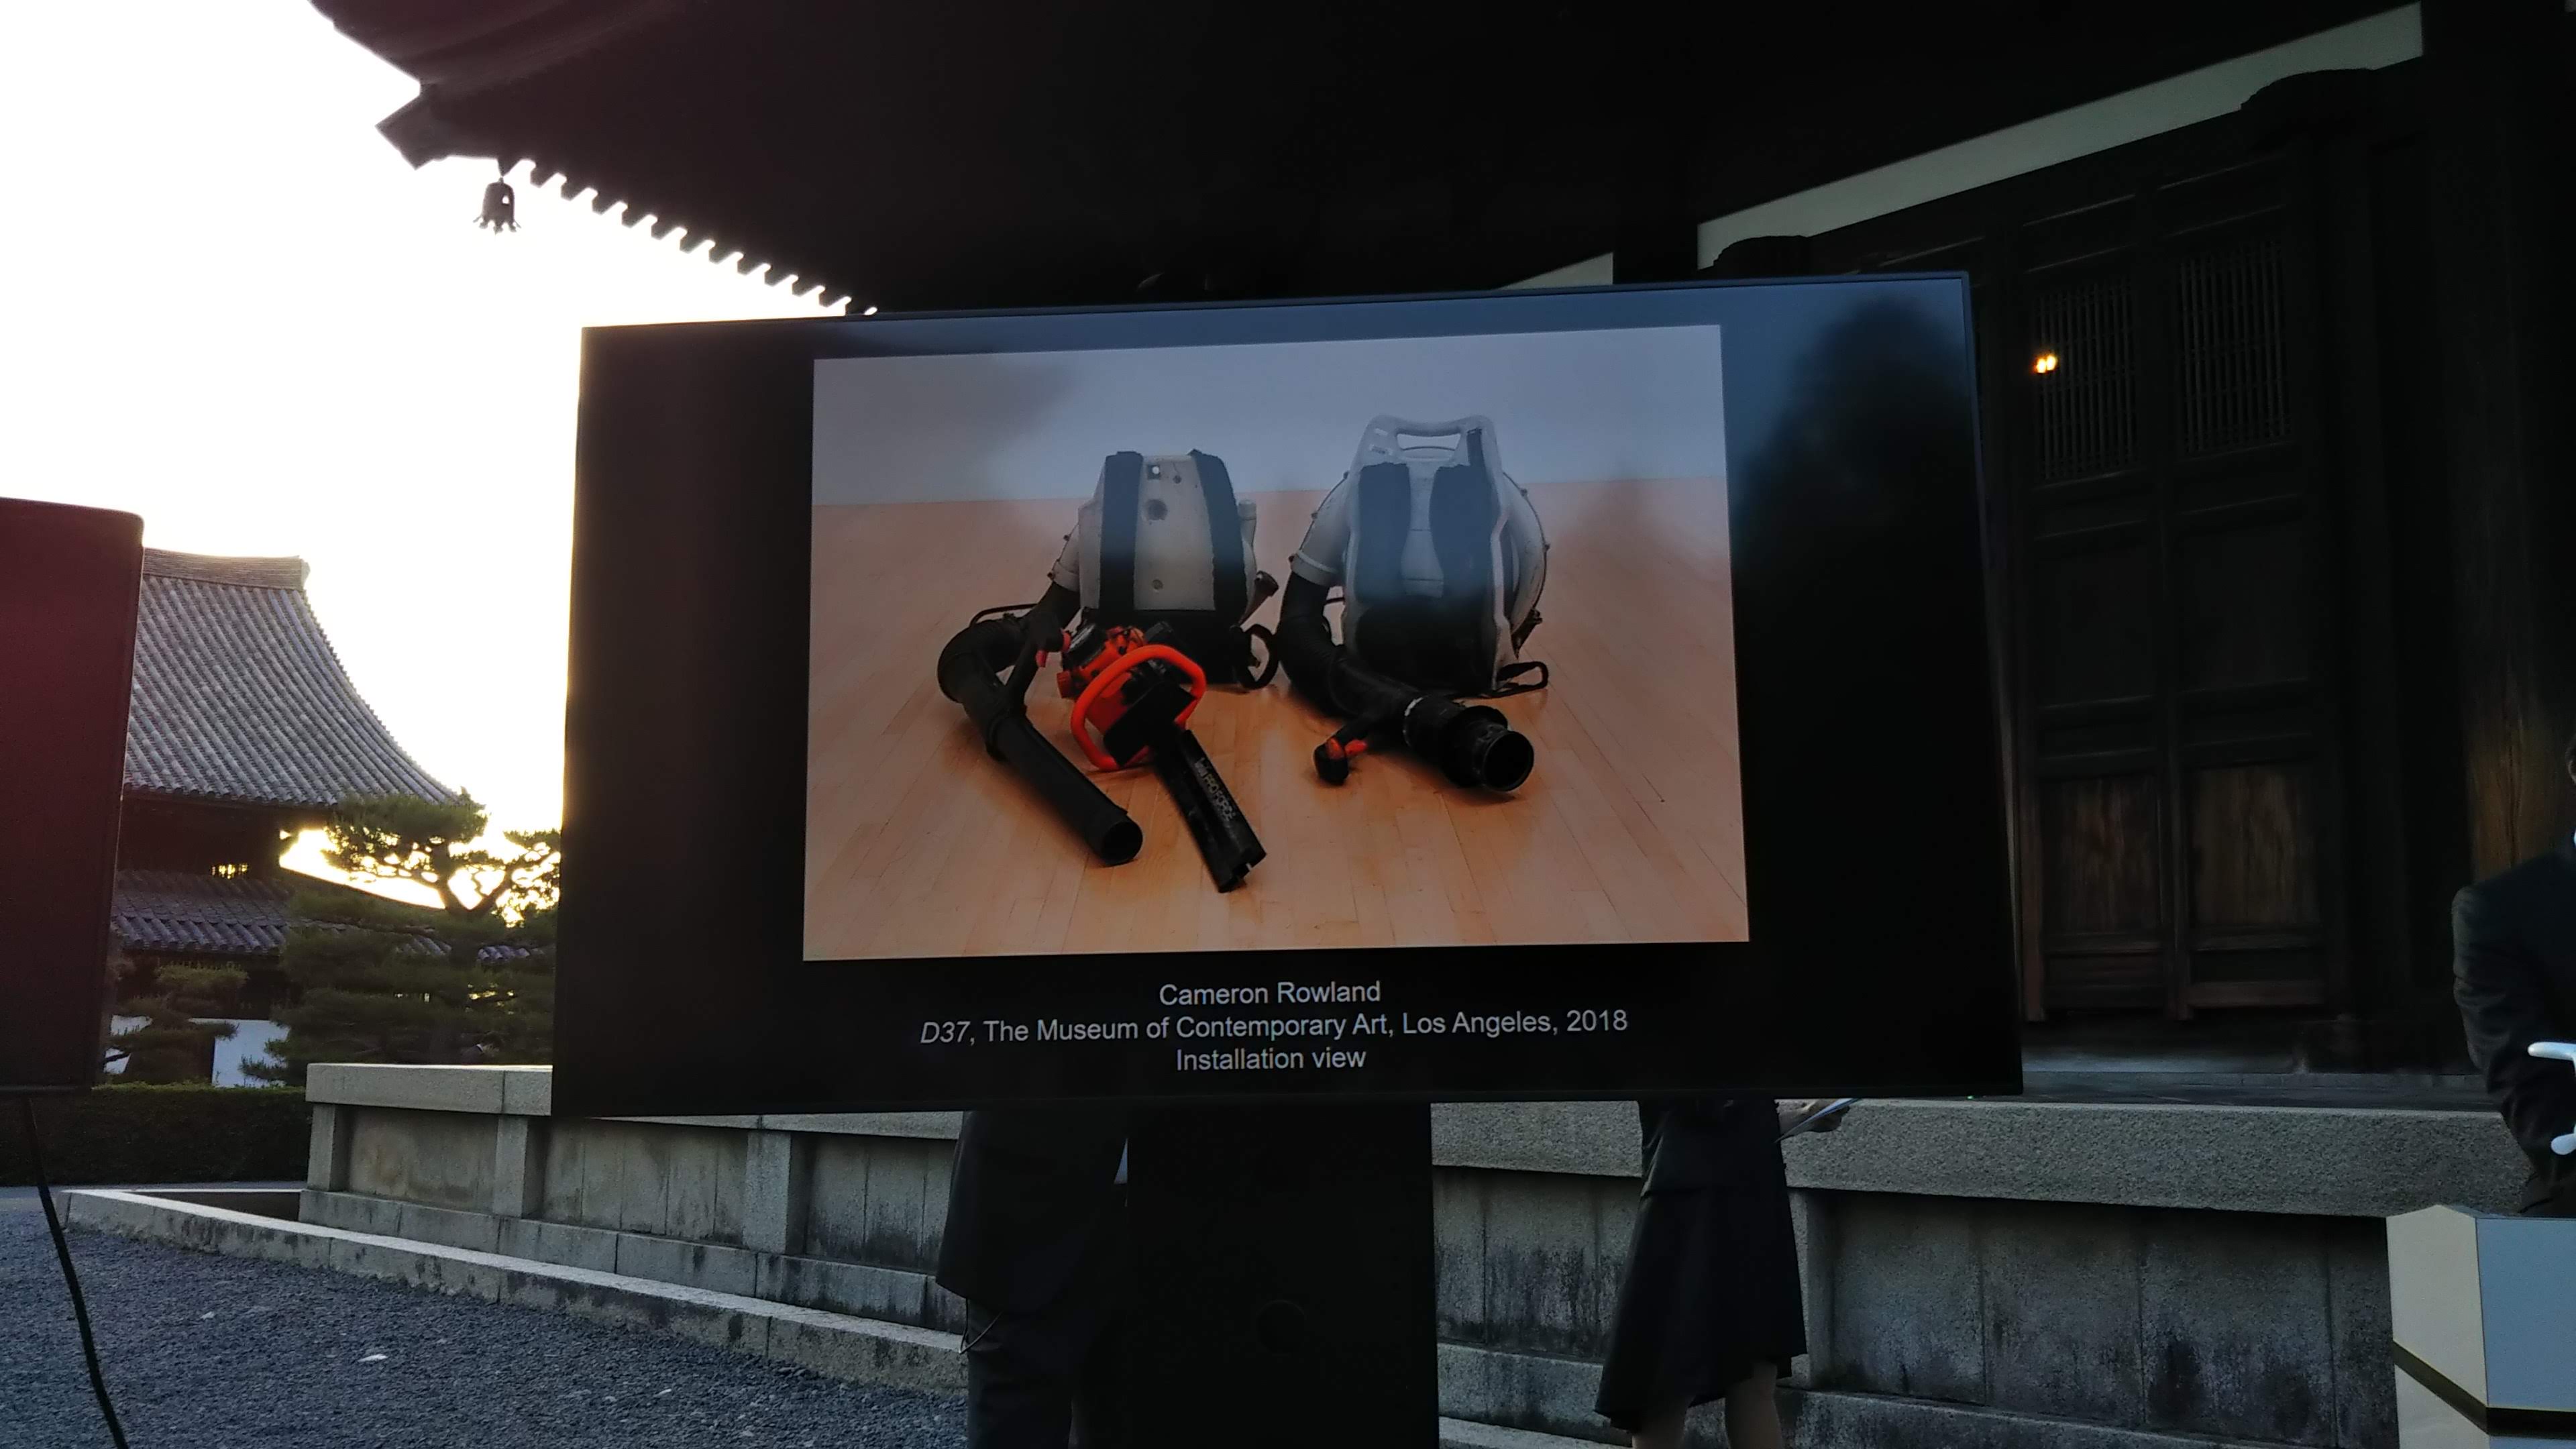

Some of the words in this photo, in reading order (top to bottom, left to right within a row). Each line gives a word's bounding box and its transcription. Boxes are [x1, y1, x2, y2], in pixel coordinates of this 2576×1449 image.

[1159, 984, 1268, 1006] Cameron
[1277, 981, 1380, 1003] Rowland
[920, 1020, 975, 1045] D37,
[983, 1020, 1028, 1042] The
[1038, 1018, 1138, 1040] Museum
[1146, 1016, 1170, 1038] of
[1177, 1016, 1346, 1041] Contemporary
[1352, 1013, 1393, 1037] Art,
[1403, 1012, 1446, 1034] Los
[1452, 1010, 1558, 1038] Angeles,
[1567, 1009, 1627, 1032] 2018
[1177, 1047, 1303, 1071] Installation
[1311, 1046, 1366, 1069] view
